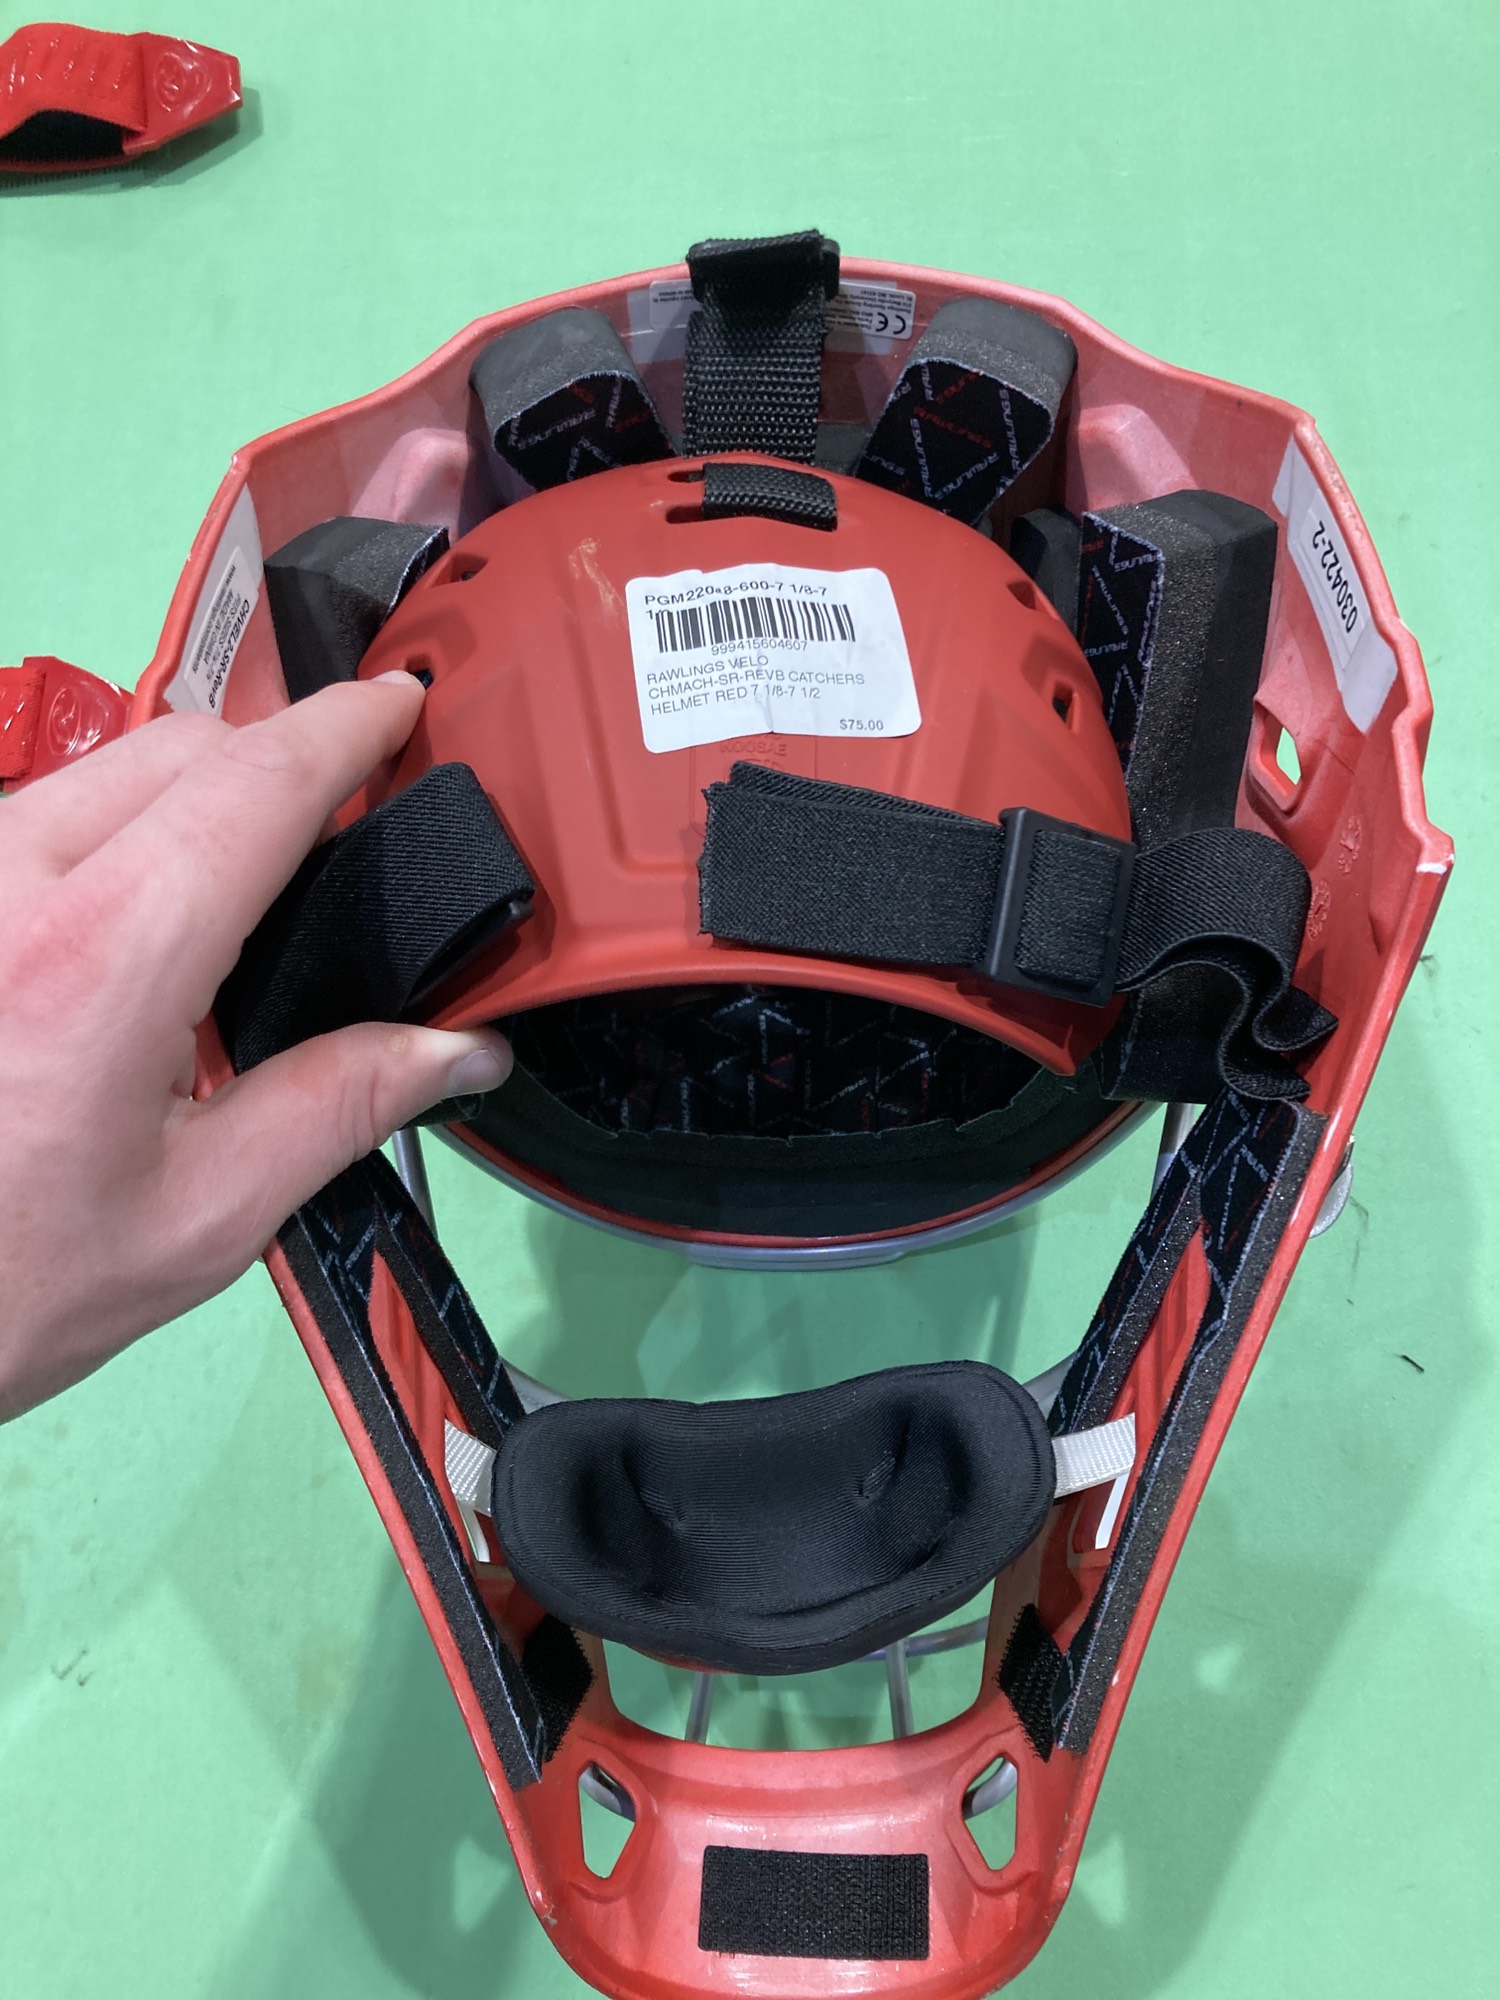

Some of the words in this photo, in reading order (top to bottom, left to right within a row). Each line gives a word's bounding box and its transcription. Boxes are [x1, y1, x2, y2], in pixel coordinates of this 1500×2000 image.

[934, 452, 1000, 500] RAWLINGS
[789, 583, 828, 597] 1/8-7
[1312, 520, 1358, 633] 030422-2
[711, 638, 808, 656] 999415604607
[646, 660, 726, 685] RAWLINGS
[728, 655, 769, 670] VELO
[648, 668, 785, 700] CHMACH-SR-REVB
[788, 670, 866, 685] CATCHERS
[651, 692, 710, 716] HELMET
[715, 686, 748, 703] RED
[750, 684, 759, 697] 7
[765, 684, 796, 698] 1/8-7
[801, 686, 821, 699] 1/2
[839, 718, 884, 731] $75.00
